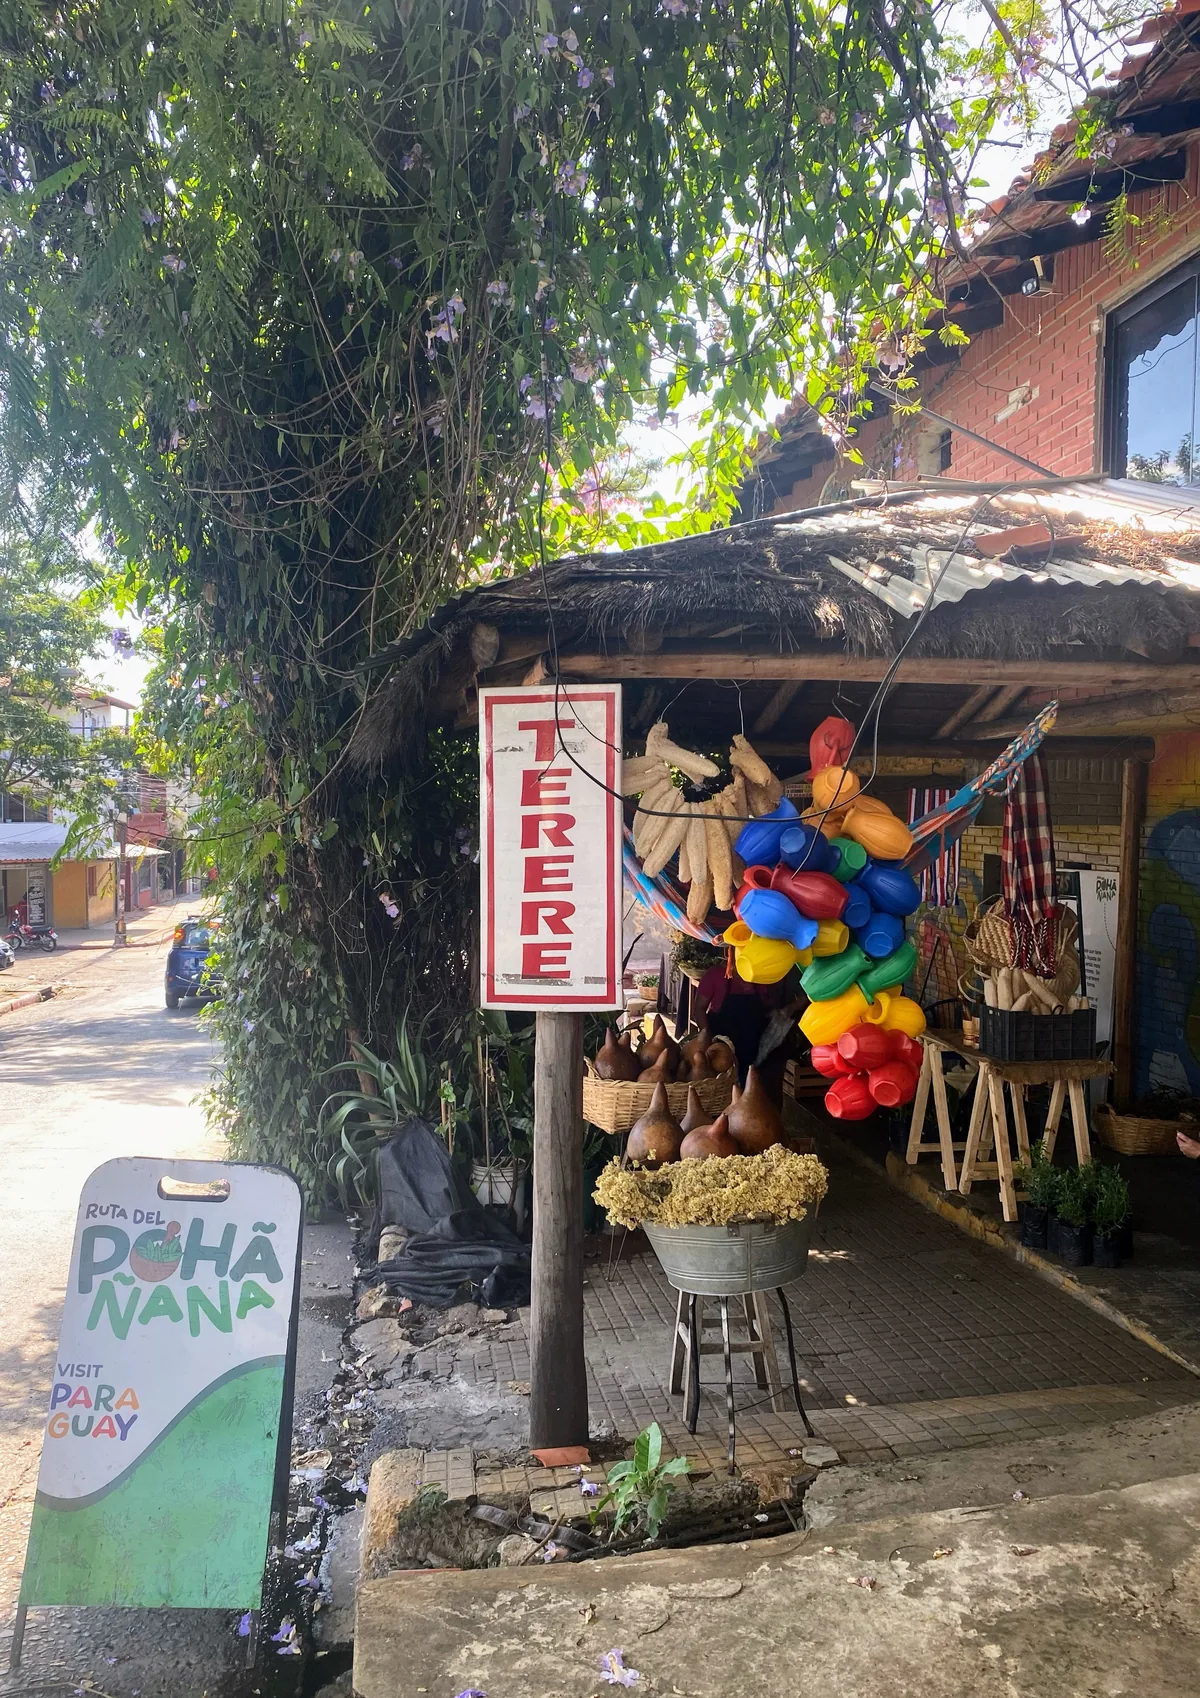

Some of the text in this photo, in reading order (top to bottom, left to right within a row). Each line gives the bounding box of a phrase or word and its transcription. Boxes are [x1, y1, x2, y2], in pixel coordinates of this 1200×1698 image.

[518, 719, 576, 980] TERERE
[86, 1203, 165, 1225] RUTA DEL
[78, 1218, 284, 1294] POHÃ
[86, 1271, 275, 1340] ÑANA
[57, 1363, 103, 1378] VISIT
[50, 1383, 140, 1412] PARA
[48, 1412, 138, 1441] GUAY
